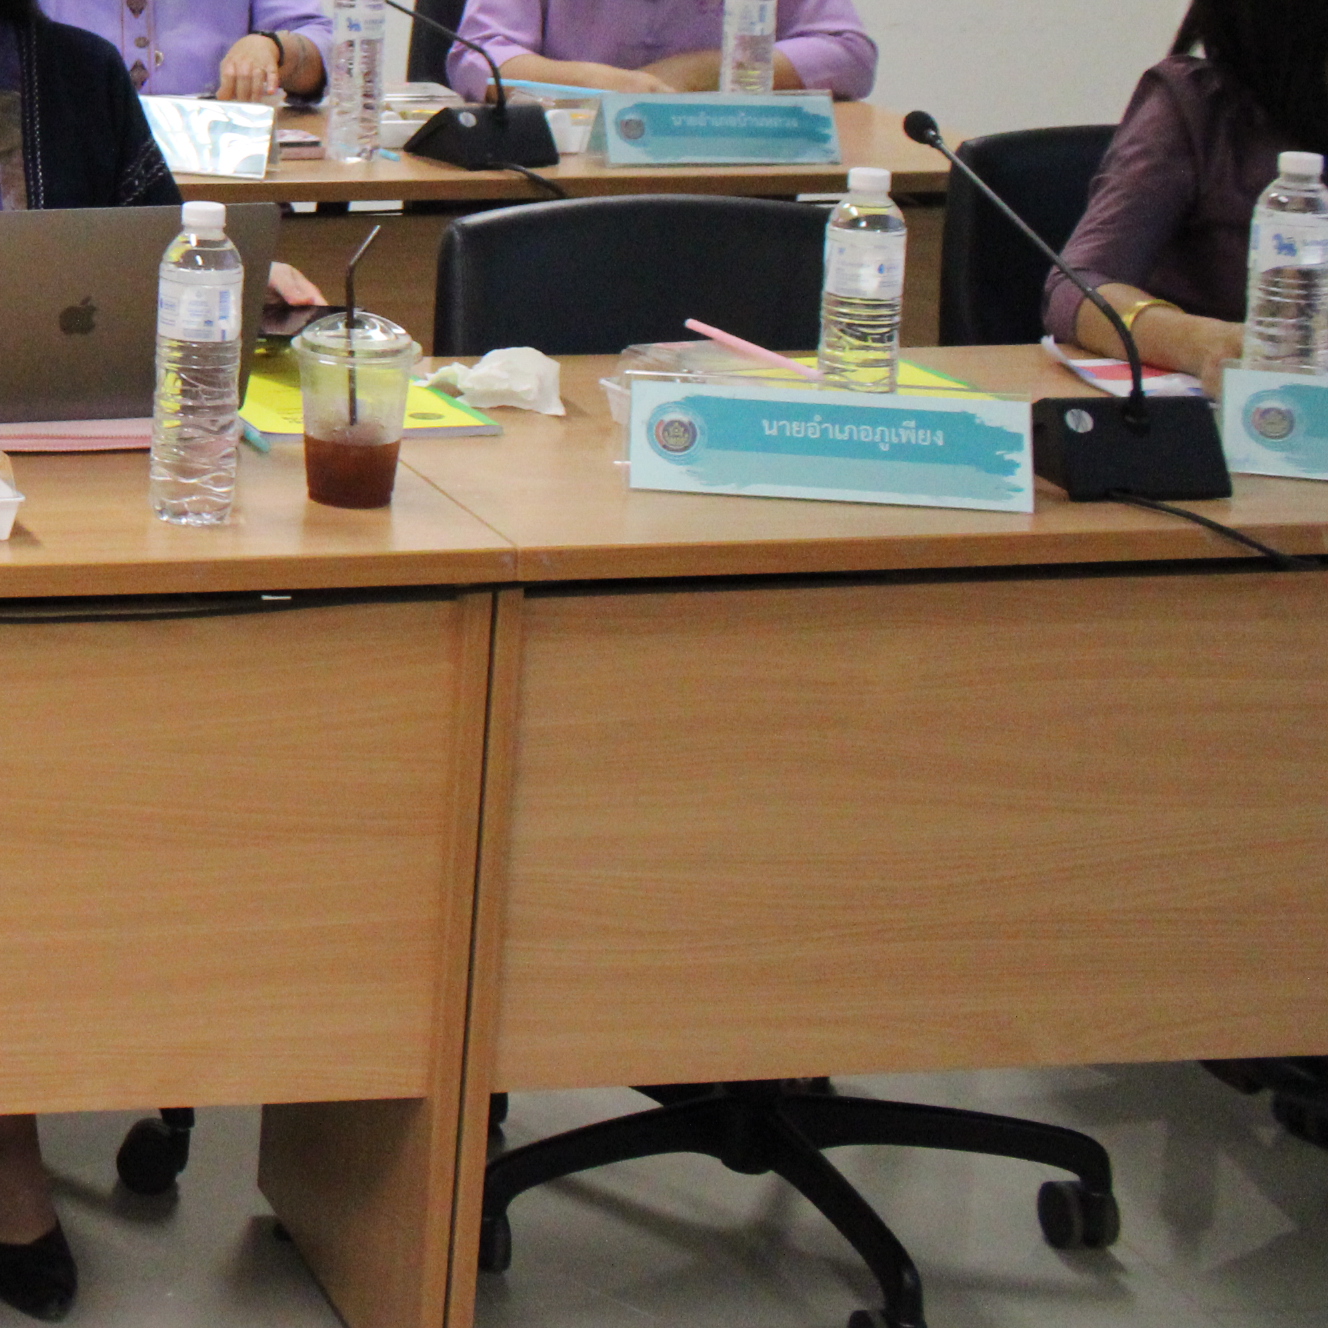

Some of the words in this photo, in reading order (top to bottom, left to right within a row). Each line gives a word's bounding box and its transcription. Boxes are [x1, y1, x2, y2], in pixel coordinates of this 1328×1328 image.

[761, 413, 945, 452] นายอำเภอภูเพียง
